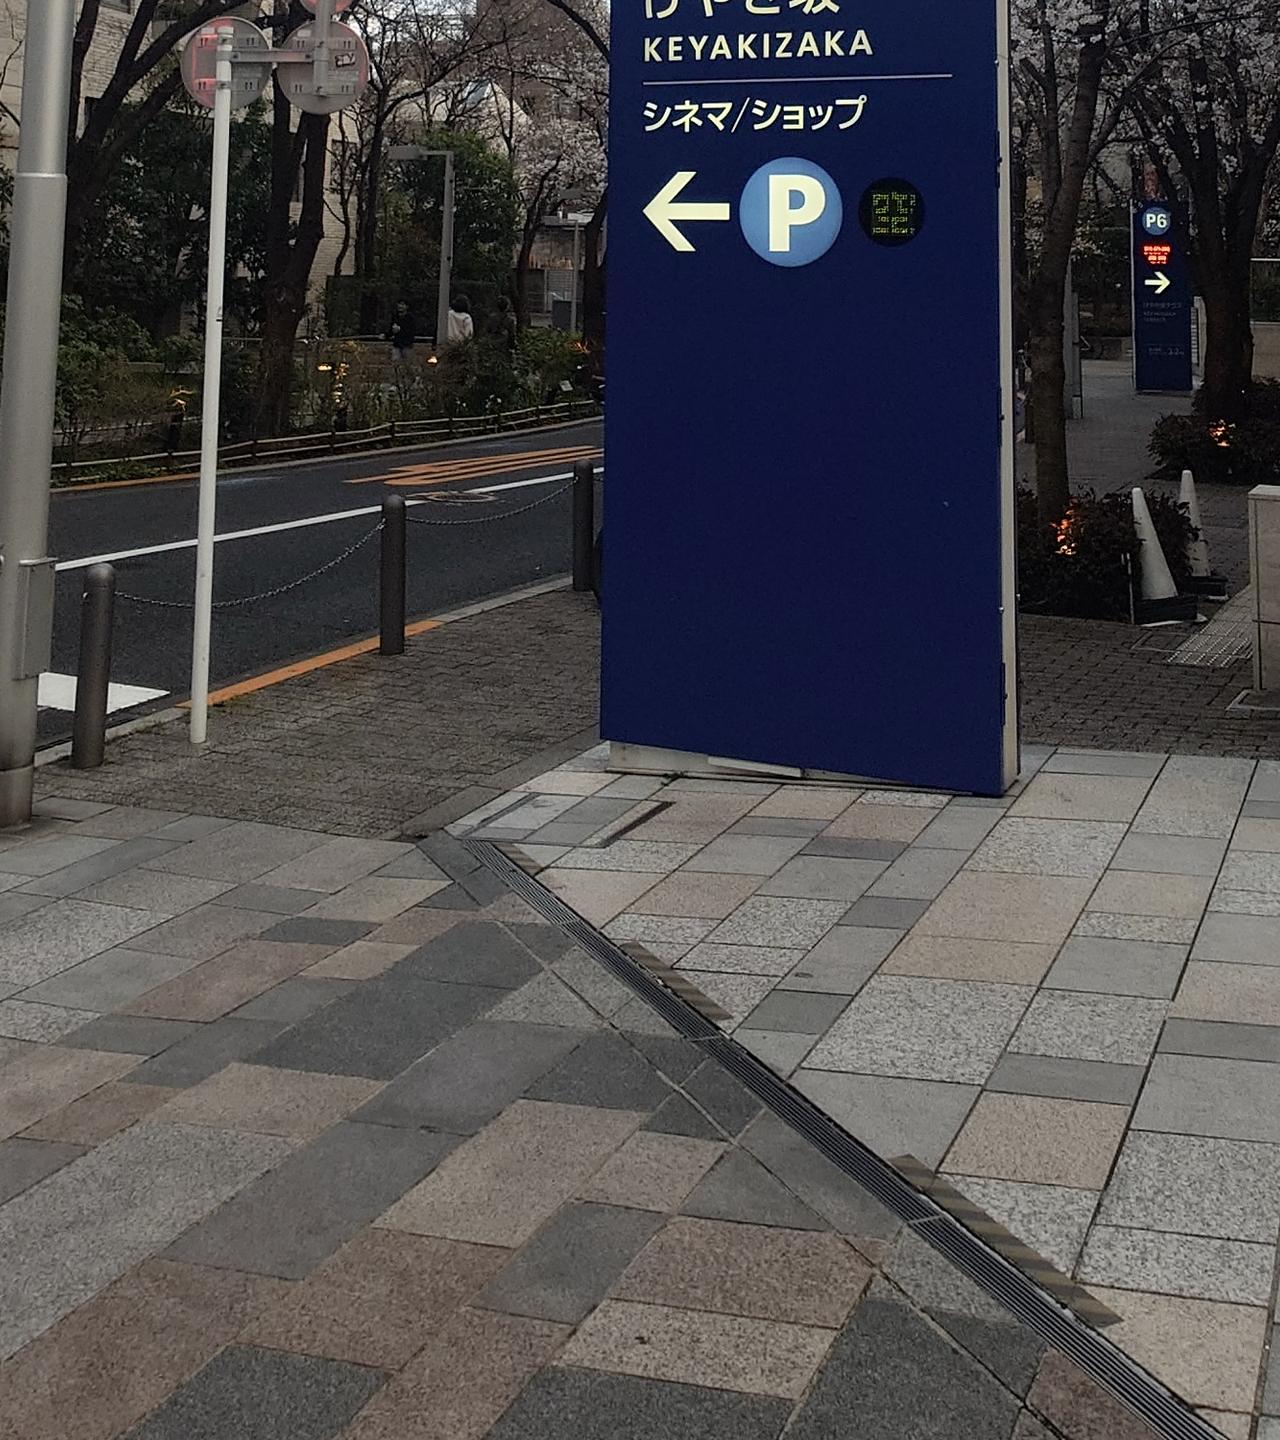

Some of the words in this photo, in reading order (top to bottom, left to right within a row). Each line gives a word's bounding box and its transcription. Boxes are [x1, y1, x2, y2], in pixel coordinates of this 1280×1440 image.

[643, 29, 874, 63] KEYAKIZAKA
[642, 94, 867, 133] シネマ/ショップ
[768, 174, 826, 252] P
[1146, 213, 1167, 228] P6
